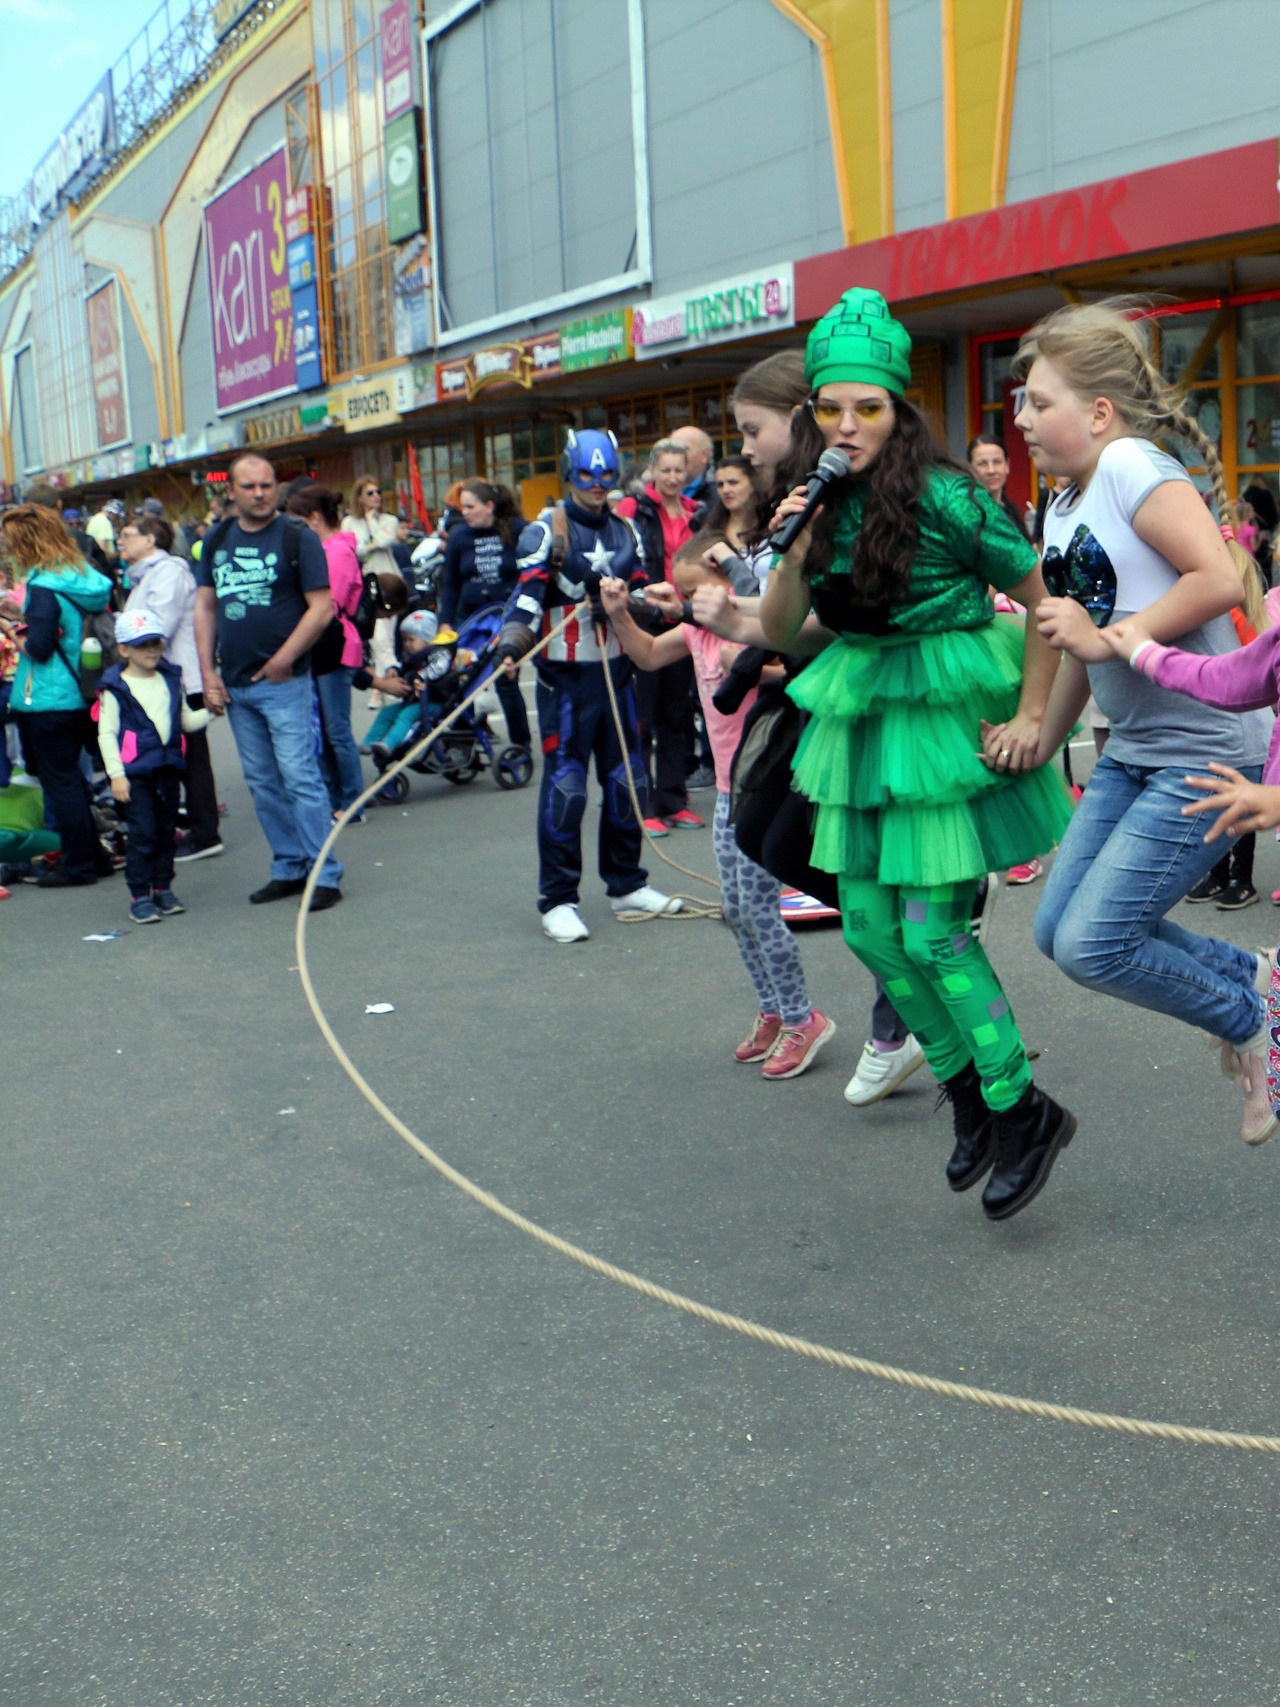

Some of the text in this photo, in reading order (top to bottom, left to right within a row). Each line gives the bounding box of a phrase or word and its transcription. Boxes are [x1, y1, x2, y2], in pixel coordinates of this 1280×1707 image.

[207, 184, 269, 354] kari
[267, 180, 285, 276] 3
[685, 281, 761, 341] ЦВЕТЫ
[348, 390, 390, 420] ЕВРОСЕТЬ
[589, 447, 607, 469] A
